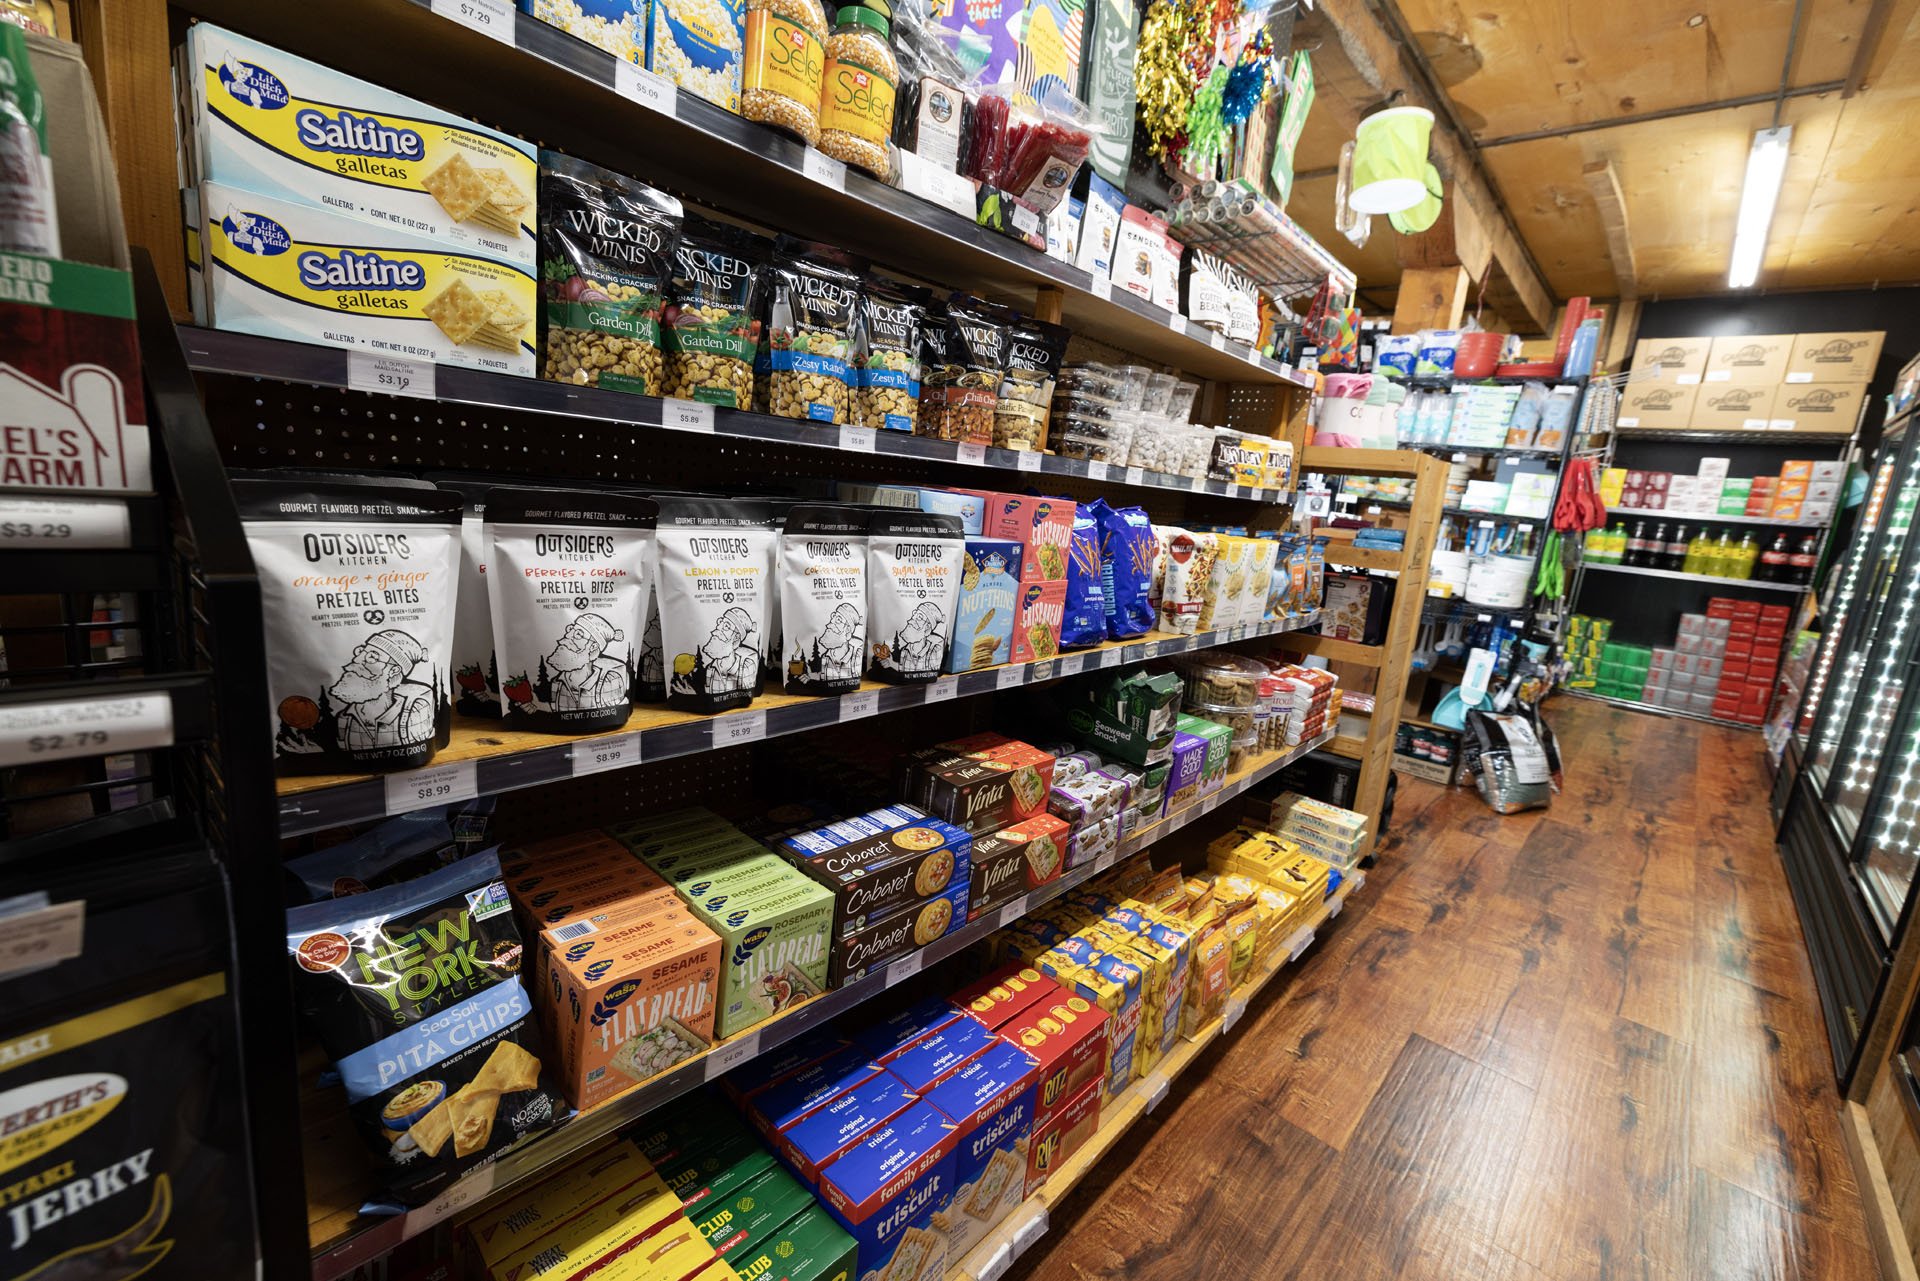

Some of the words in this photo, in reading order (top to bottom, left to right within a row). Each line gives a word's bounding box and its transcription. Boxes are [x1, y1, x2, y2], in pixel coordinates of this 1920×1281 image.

[461, 3, 491, 25] $7.29
[967, 3, 1002, 21] that!
[692, 22, 713, 38] BUTTER
[633, 52, 639, 64] 3
[250, 77, 282, 95] Dutch
[258, 72, 276, 86] Lil'
[636, 83, 658, 99] $5.09
[731, 98, 736, 109] 3
[301, 112, 421, 157] Saltine
[336, 156, 408, 180] galletas
[322, 195, 354, 211] GALLETAS
[407, 219, 415, 228] OZ
[416, 221, 429, 232] (227
[568, 209, 660, 253] WICKED
[483, 239, 508, 252] PAQUETES
[591, 236, 646, 264] MINIS
[301, 254, 421, 287] Saltine
[582, 267, 618, 283] SNACKING
[619, 277, 657, 291] CRACKERS
[684, 270, 732, 290] MINIS
[785, 272, 852, 307] WICKED
[337, 293, 409, 310] galletas
[711, 301, 745, 310] CRACKERS
[800, 295, 837, 316] MINIS
[588, 312, 633, 331] Garden
[636, 321, 652, 336] Dill
[873, 320, 907, 337] MINIS
[682, 334, 723, 349] Garden
[726, 340, 742, 352] Dill
[972, 343, 998, 357] MINIS
[795, 356, 820, 371] Zesty
[1009, 356, 1035, 371] MINIS
[378, 374, 410, 390] $3.19
[872, 372, 895, 383] Zesty
[680, 413, 699, 424] $5.89
[280, 503, 317, 513] GOURMET
[321, 504, 359, 514] FLAVORED
[362, 505, 394, 514] PRETZEL
[397, 506, 420, 514] SNACK
[583, 512, 606, 520] PRETZEL
[1, 523, 71, 538] $3.29
[339, 555, 387, 566] KITCHEN
[293, 575, 359, 592] orange
[377, 570, 429, 591] ginger
[525, 568, 576, 577] BERRIES
[590, 568, 626, 577] CREAM
[685, 568, 720, 577] LEMON
[541, 581, 586, 594] PRETZEL
[592, 581, 614, 593] BITES
[698, 579, 731, 590] PRETZEL
[734, 578, 754, 589] BITES
[813, 578, 838, 589] PRETZEL
[842, 578, 856, 588] BITES
[898, 578, 926, 587] PRETZEL
[927, 578, 943, 587] BITES
[1102, 564, 1116, 616] OVERRATED
[316, 591, 378, 609] PRETZEL
[384, 589, 419, 605] BITES
[591, 710, 599, 718] OZ
[731, 727, 750, 738] $8.99
[1094, 719, 1132, 741] Seaweed
[1094, 726, 1118, 744] Snack
[27, 731, 108, 751] $2.79
[1210, 733, 1228, 750] MADE
[596, 751, 620, 763] $8.99
[1182, 747, 1204, 765] MADE
[957, 766, 984, 780] Vinta
[418, 785, 450, 799] $8.99
[966, 784, 1006, 819] Vinta
[974, 838, 1000, 854] Vinta
[827, 840, 892, 872] Cabaret
[715, 861, 768, 885] ROSEMARY
[982, 855, 1022, 894] Vinta
[730, 874, 785, 899] ROSEMARY
[846, 866, 914, 915] Cabaret
[751, 889, 806, 913] ROSEMARY
[774, 906, 827, 931] ROSEMARY
[603, 921, 656, 943] SESAME
[355, 910, 470, 983] NEW
[622, 938, 675, 961] SESAME
[846, 918, 912, 970] Cabaret
[652, 951, 709, 980] SESAME
[807, 959, 826, 972] THINS
[373, 940, 490, 1011] YORK
[420, 1018, 450, 1038] Sea
[450, 1001, 480, 1021] Salt
[688, 1011, 712, 1027] THINS
[377, 1039, 446, 1085] PITA
[450, 996, 523, 1046] CHIPS
[441, 1053, 464, 1069] BAKED
[464, 1044, 482, 1057] FROM
[482, 1036, 498, 1048] REAL
[723, 1050, 743, 1064] $4.09
[933, 1052, 955, 1067] original
[975, 1080, 996, 1097] original
[1043, 1066, 1069, 1107] RITZ
[830, 1096, 856, 1114] triscuit
[976, 1097, 1006, 1123] family
[1008, 1082, 1026, 1097] size
[511, 1109, 527, 1126] NO
[839, 1115, 865, 1134] original
[868, 1127, 895, 1149] triscuit
[973, 1104, 1024, 1156] triscuit
[1036, 1128, 1060, 1170] RITZ
[880, 1149, 905, 1171] original
[880, 1167, 918, 1202] family
[920, 1149, 942, 1172] size
[8, 1148, 154, 1250] JERKY
[826, 1184, 847, 1207] family
[877, 1175, 941, 1240] triscuit
[697, 1209, 733, 1239] CLUB
[659, 1239, 681, 1254] original
[720, 1235, 743, 1252] Original
[528, 1242, 563, 1267] WHEAT
[532, 1251, 569, 1277] THINS
